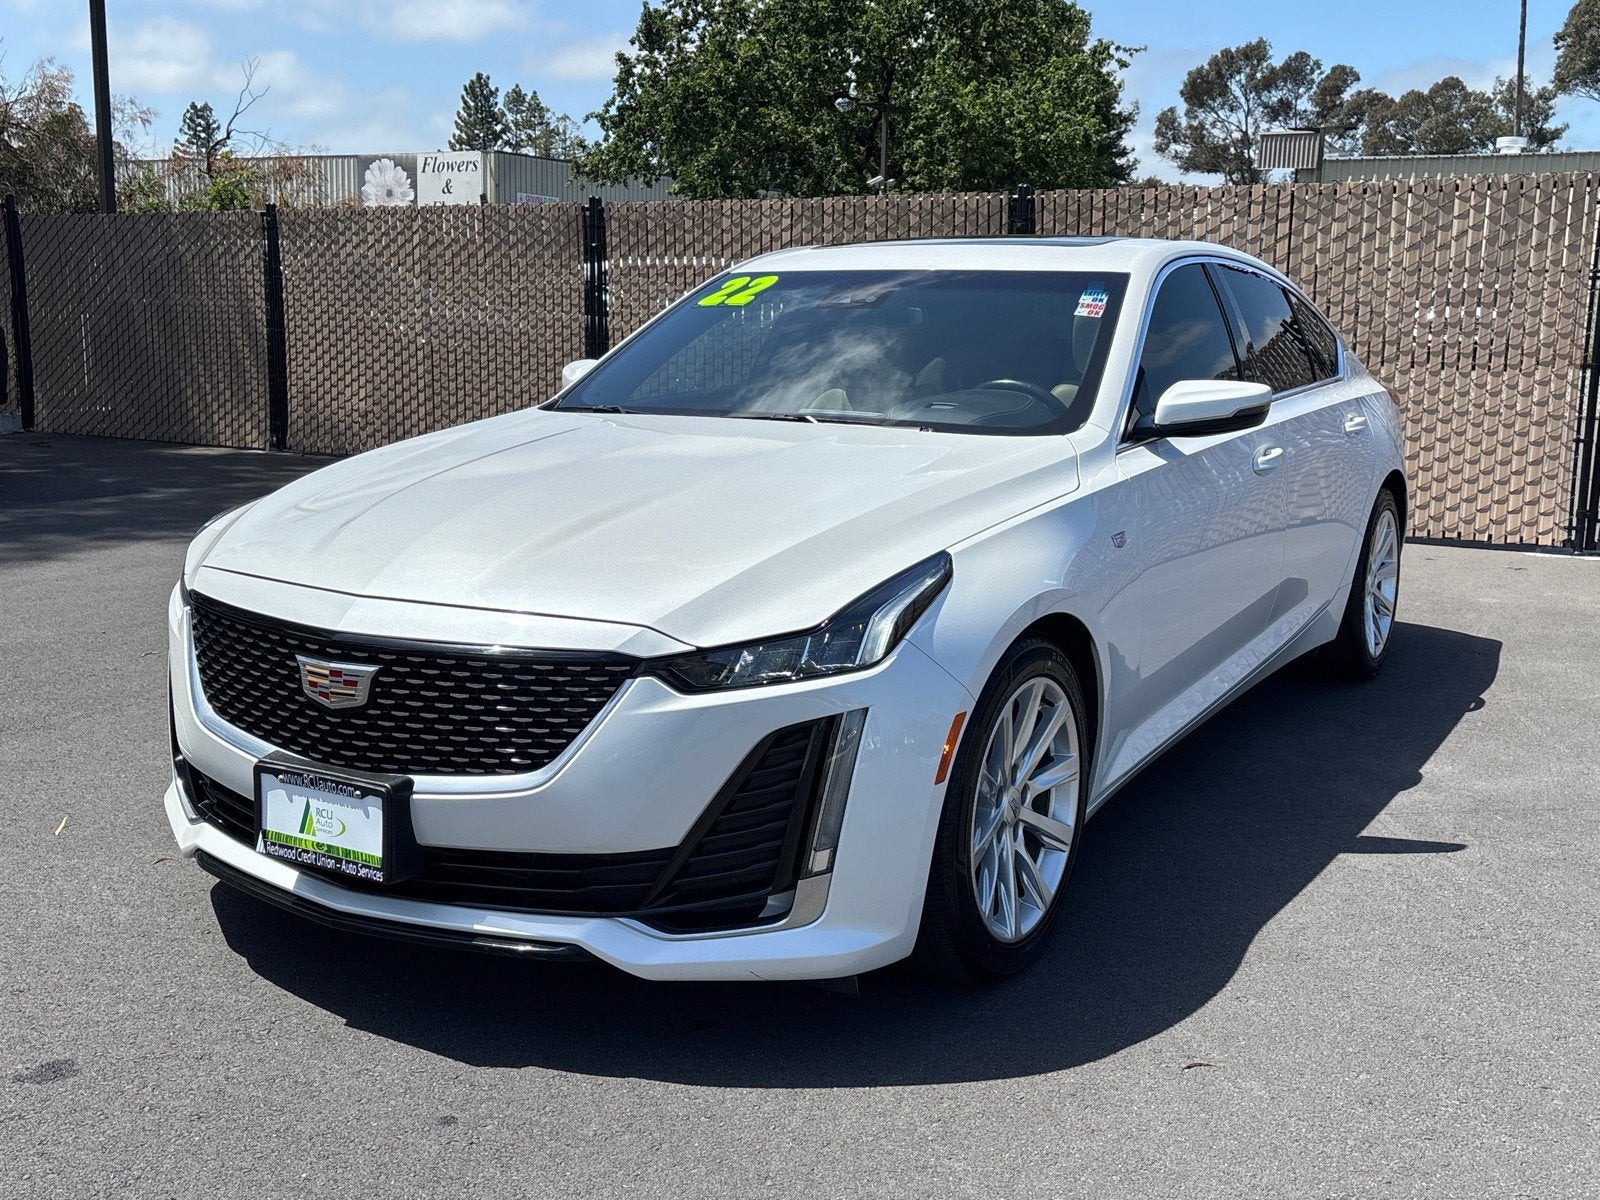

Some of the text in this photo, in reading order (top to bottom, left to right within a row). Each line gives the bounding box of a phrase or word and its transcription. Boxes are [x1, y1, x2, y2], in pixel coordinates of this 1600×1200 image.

[420, 156, 479, 174] Flowers
[441, 178, 453, 195] &
[697, 275, 779, 307] 22
[1079, 302, 1106, 311] SMOG
[315, 807, 333, 820] RCU
[315, 817, 334, 829] Auto
[266, 841, 296, 860] Redwood
[296, 848, 316, 865] Credit
[316, 854, 335, 870] Union
[341, 859, 357, 875] Auto
[357, 863, 384, 882] Services
